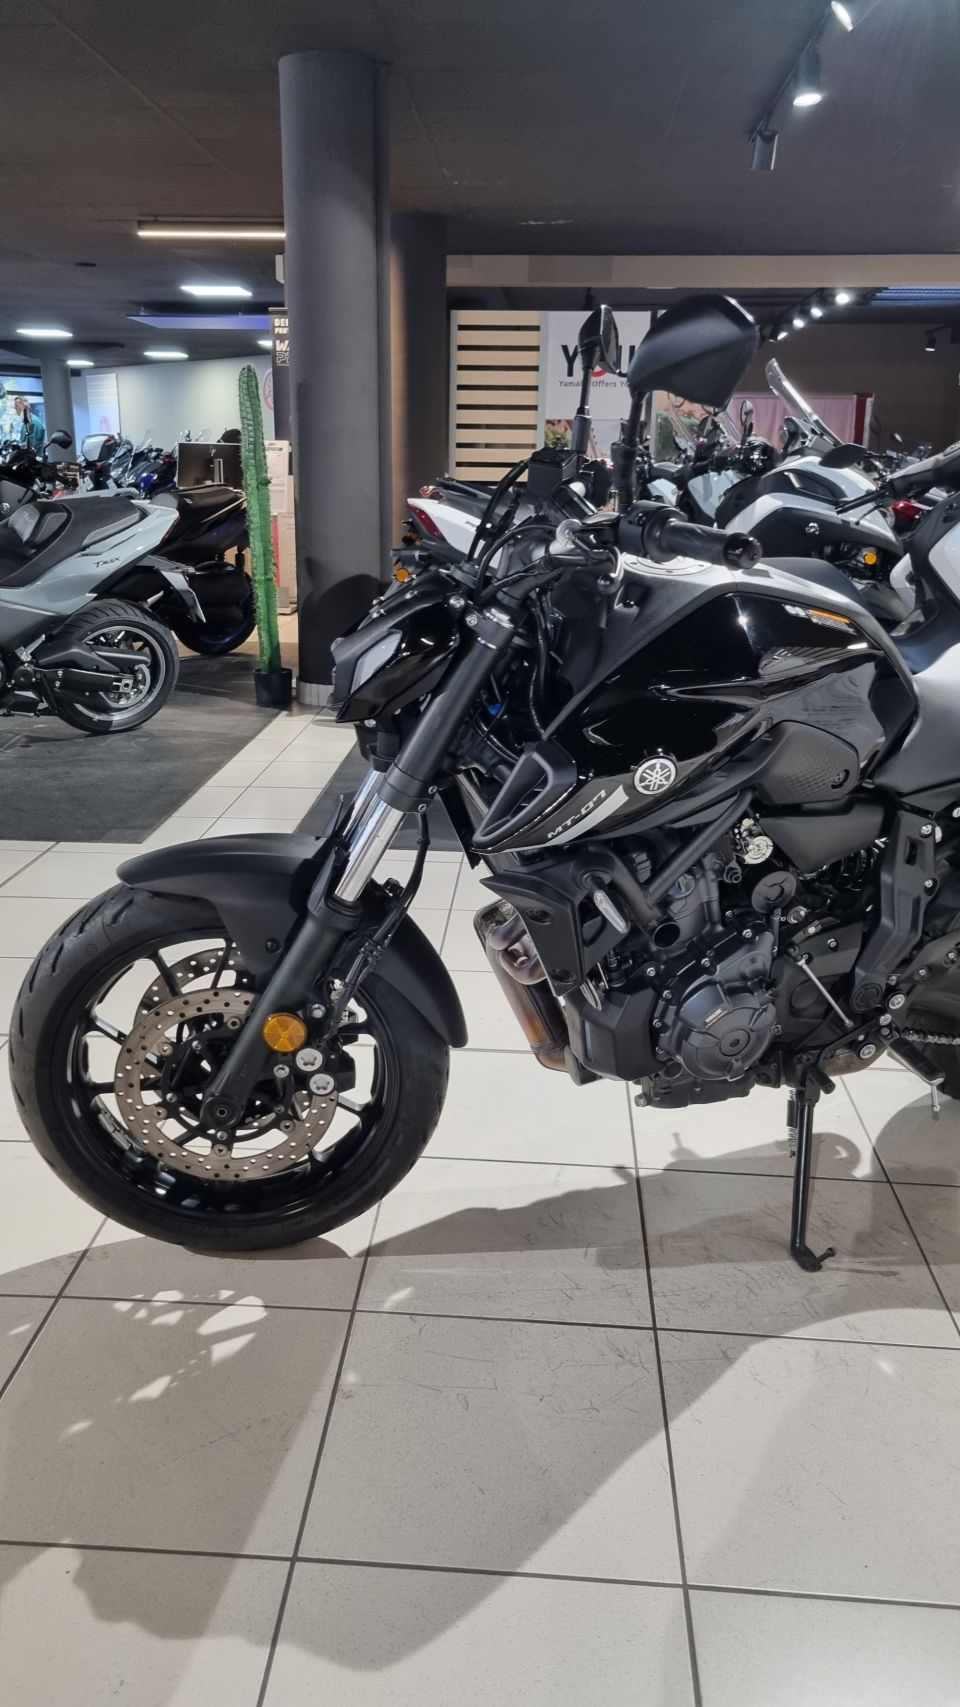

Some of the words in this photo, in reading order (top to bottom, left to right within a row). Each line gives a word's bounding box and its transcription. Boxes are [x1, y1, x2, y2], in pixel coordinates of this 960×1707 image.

[276, 340, 290, 351] W
[592, 380, 617, 388] Offers
[547, 789, 606, 839] MT-07
